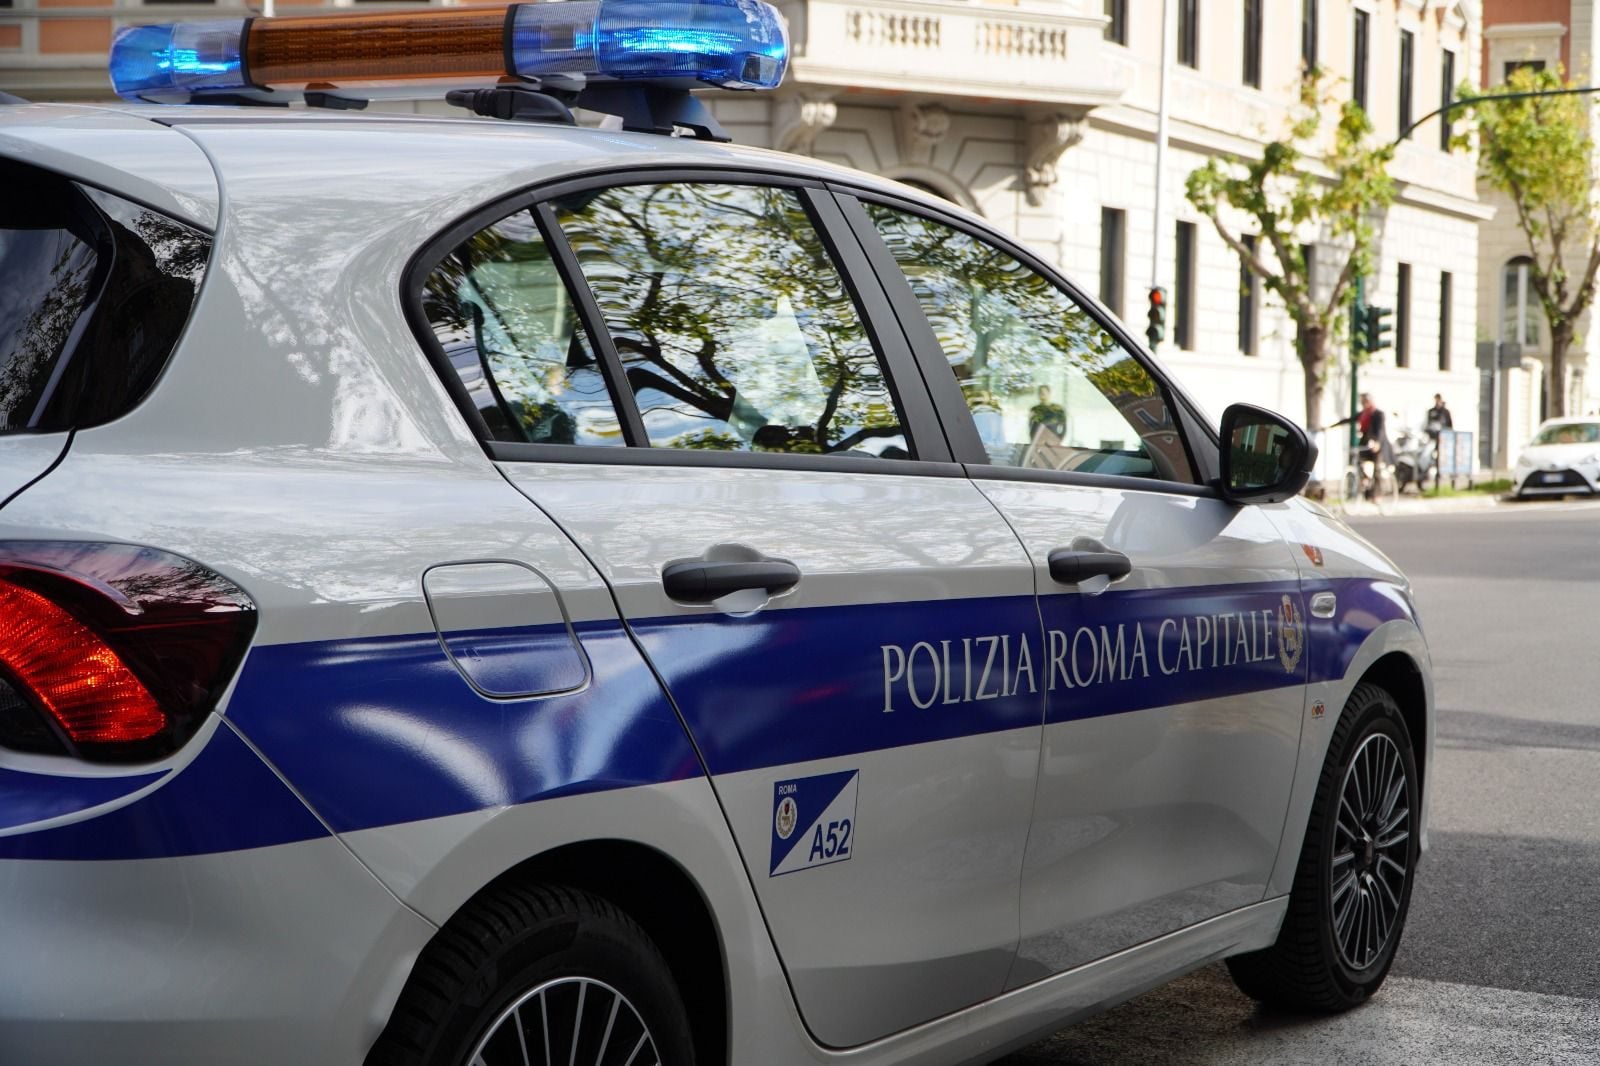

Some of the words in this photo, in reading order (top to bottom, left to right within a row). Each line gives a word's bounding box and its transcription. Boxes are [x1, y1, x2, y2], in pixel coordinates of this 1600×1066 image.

[881, 632, 1037, 713] POLIZIA
[1048, 623, 1150, 691] ROMA
[1157, 609, 1276, 675] CAPITALE
[778, 783, 798, 796] ROMA
[808, 818, 851, 862] A52
